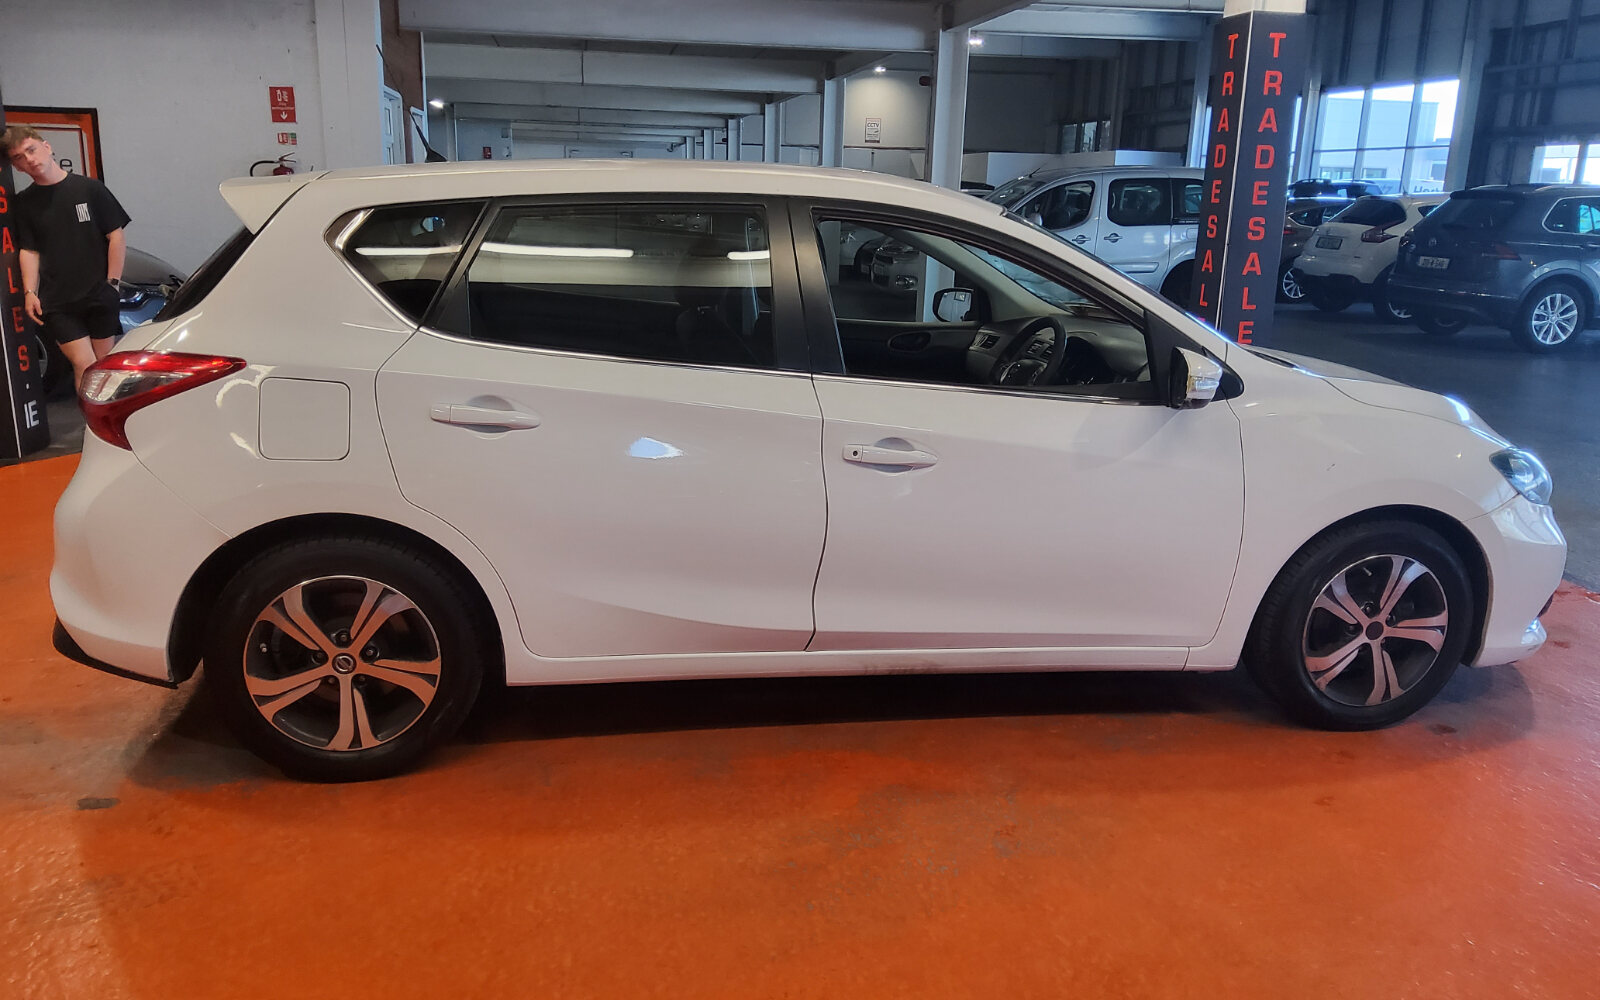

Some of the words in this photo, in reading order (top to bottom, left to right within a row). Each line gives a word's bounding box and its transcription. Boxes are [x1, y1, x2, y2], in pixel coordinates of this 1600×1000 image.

[0, 167, 40, 429] SALES.IE
[1198, 33, 1239, 322] TRADESAL
[1237, 33, 1287, 344] TRADESALE
